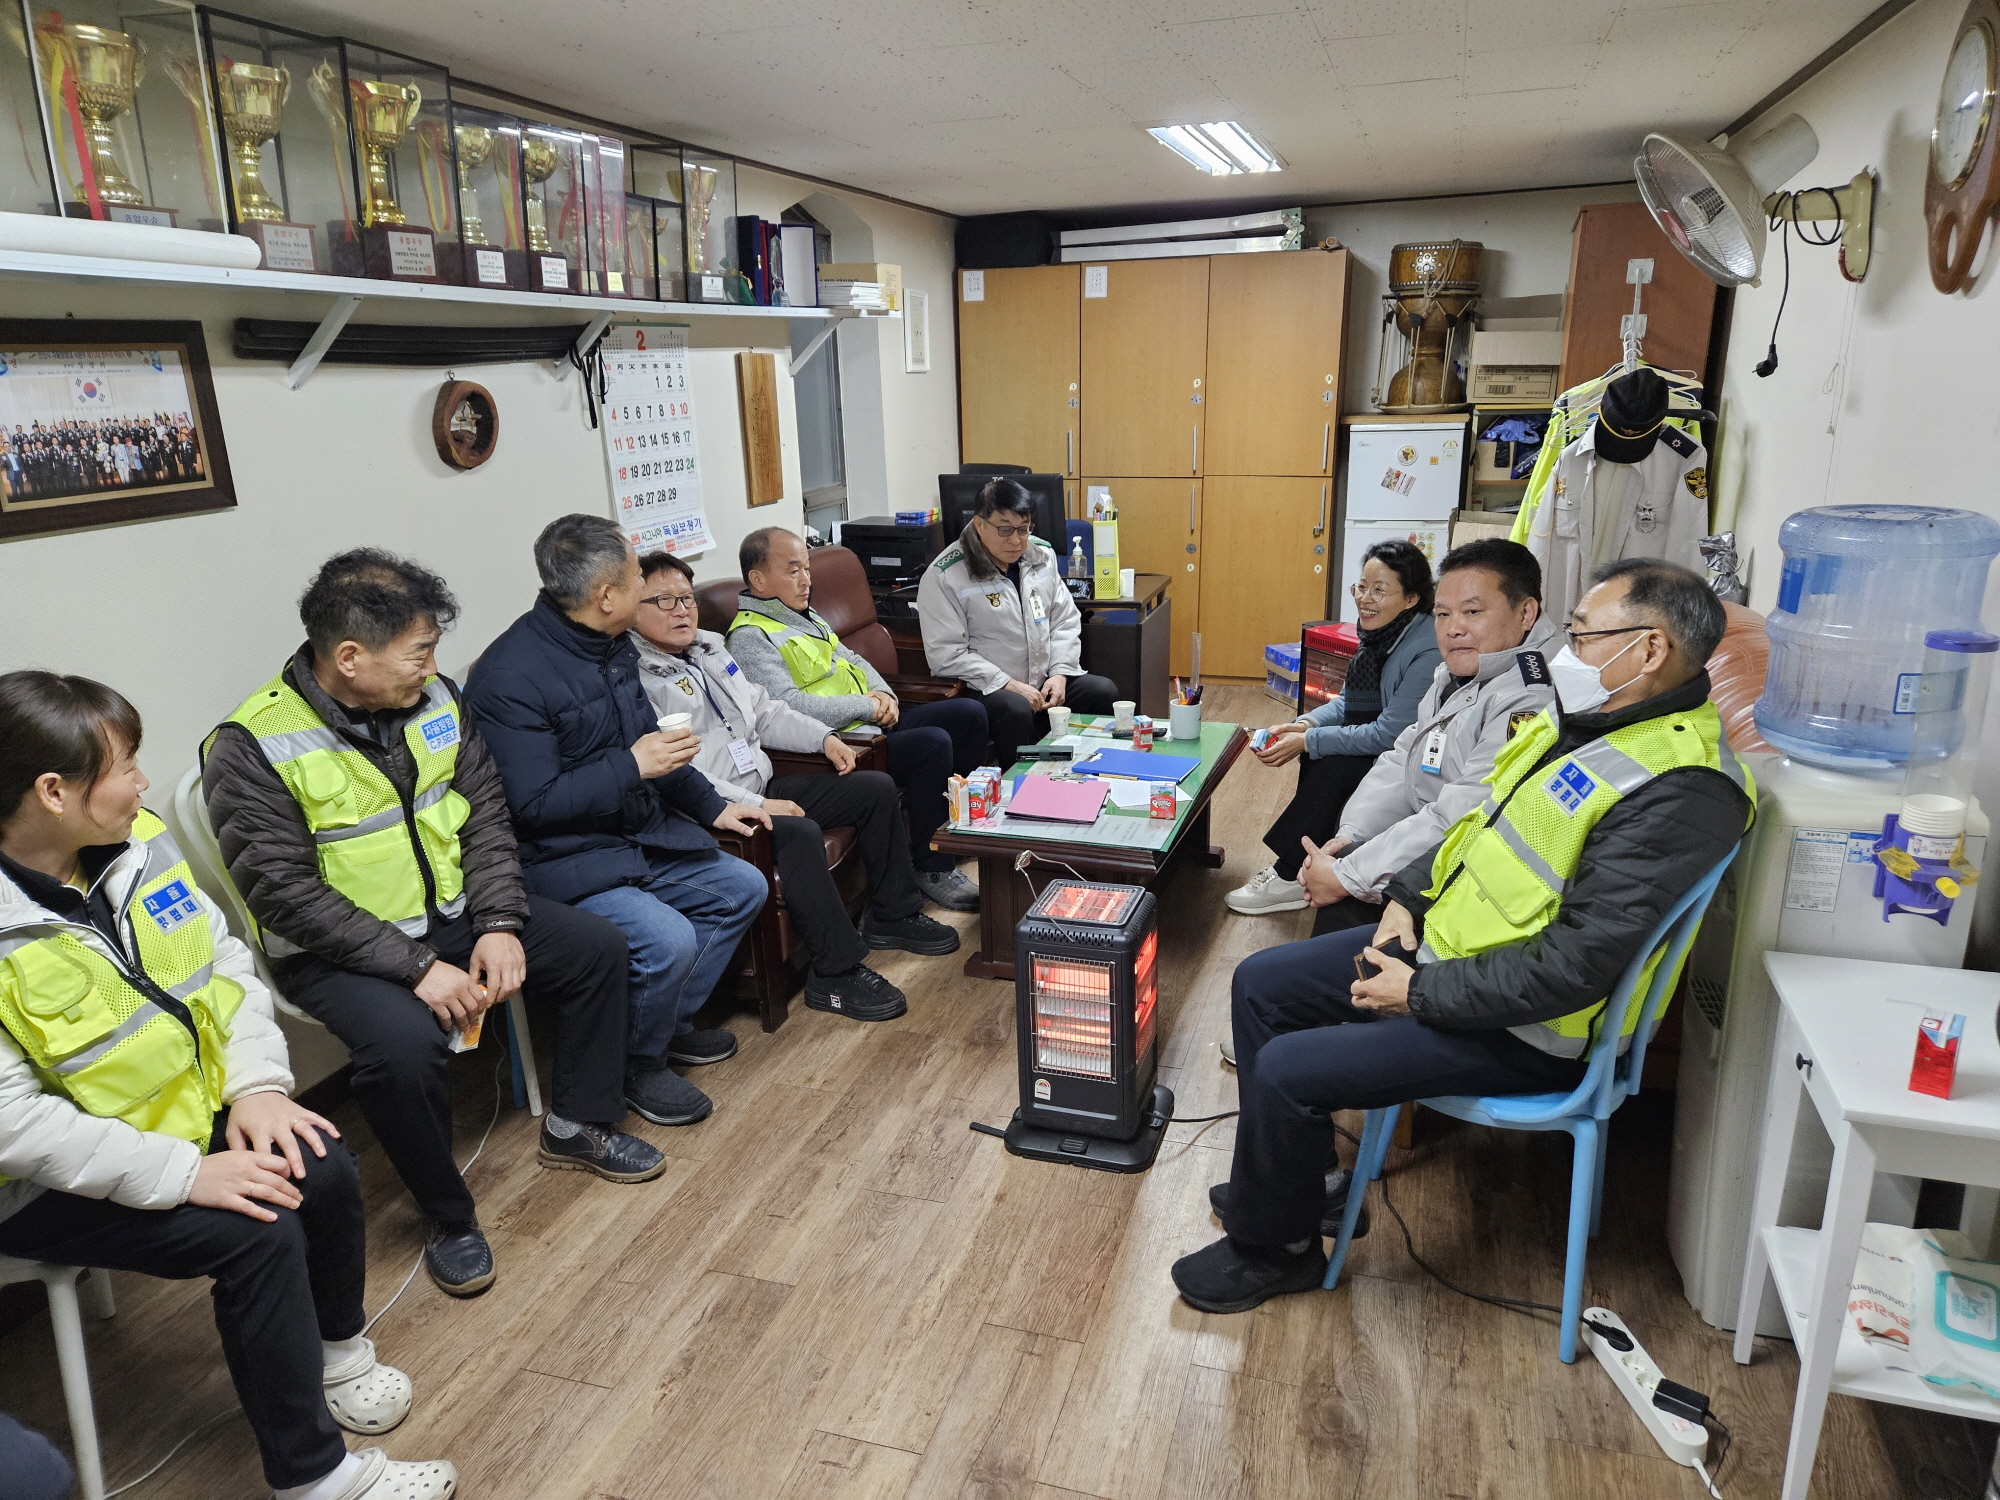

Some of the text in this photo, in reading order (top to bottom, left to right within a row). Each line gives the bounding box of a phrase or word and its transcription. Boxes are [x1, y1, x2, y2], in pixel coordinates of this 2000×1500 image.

[636, 330, 646, 351] 2
[655, 375, 684, 388] 1 2 3
[611, 402, 688, 421] 4 5 6 7 8 9 10
[614, 430, 691, 451] 11 12 13 14 15 16 17
[618, 457, 695, 480] 18 19 20 21 22 23 24
[622, 487, 677, 509] 25 26 27 28 29
[641, 527, 663, 541] 시그니아
[662, 517, 702, 537] 독일보정기
[423, 715, 454, 737] 자율방범
[145, 886, 182, 912] 자율
[156, 899, 198, 929] 방범대
